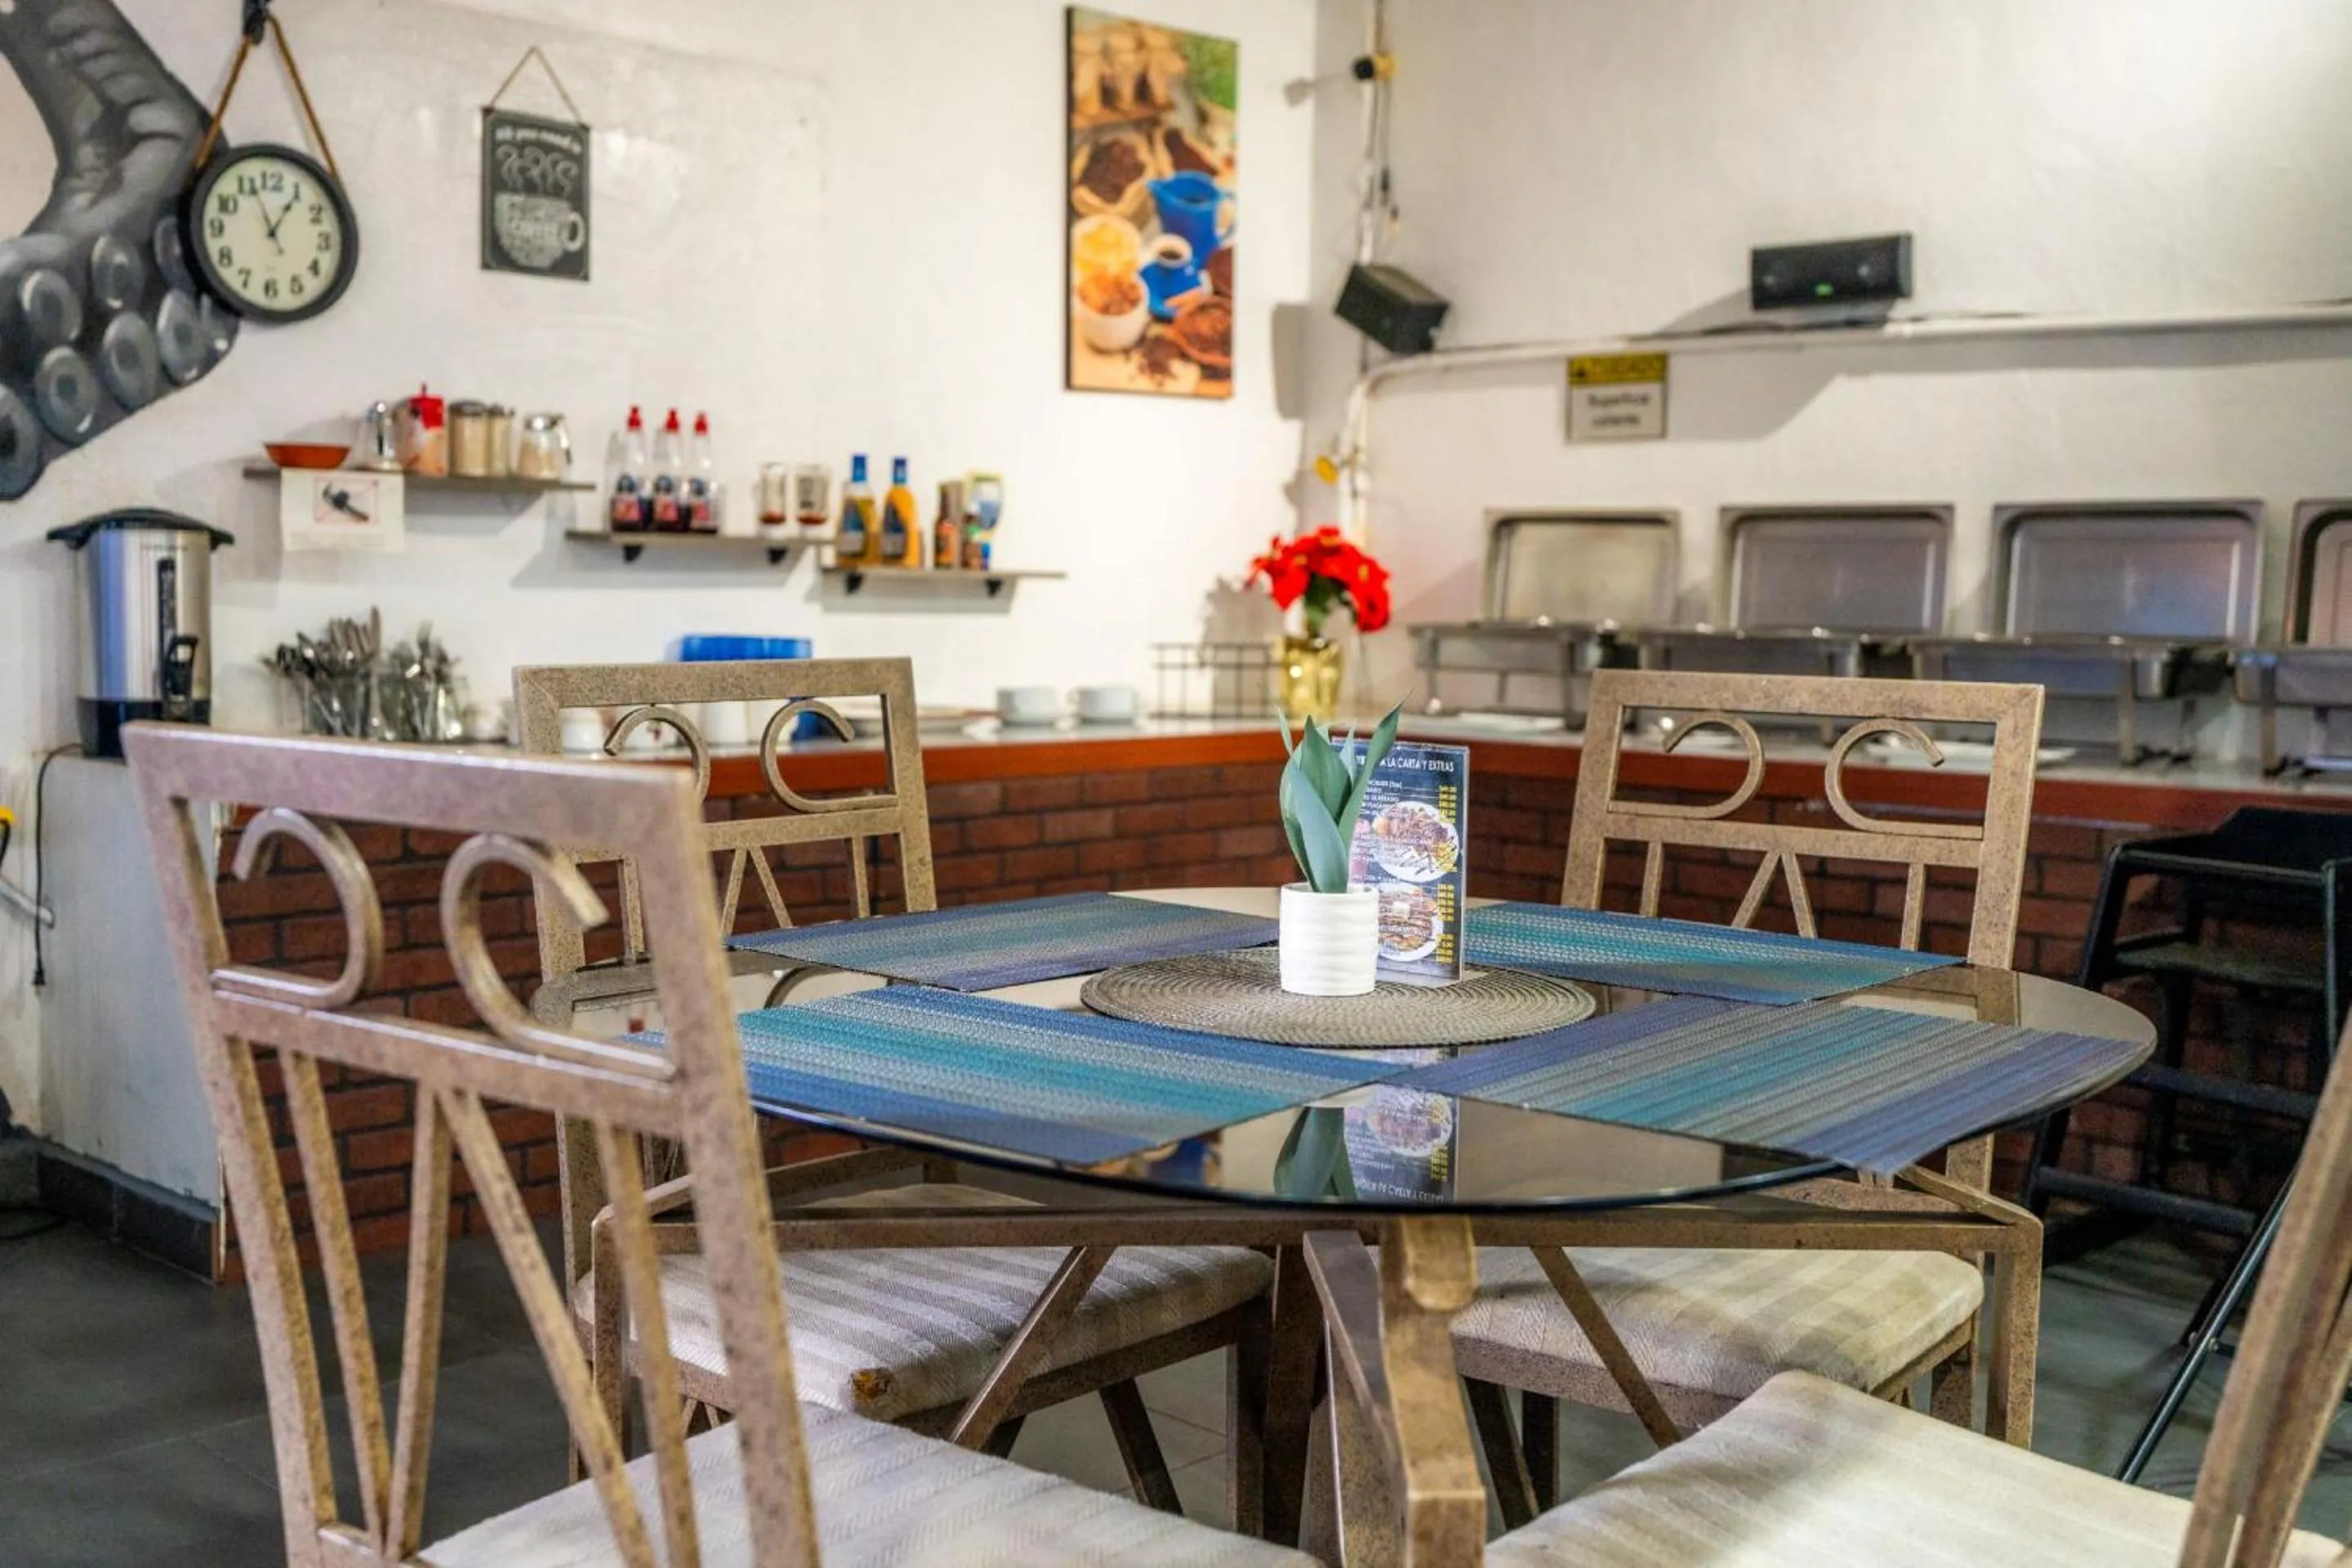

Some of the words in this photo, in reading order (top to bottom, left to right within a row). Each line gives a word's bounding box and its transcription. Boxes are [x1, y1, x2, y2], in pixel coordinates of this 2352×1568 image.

[237, 174, 258, 196] 11
[260, 170, 284, 193] 12
[293, 180, 301, 202] 1
[217, 193, 238, 214] 10
[309, 203, 323, 225] 2
[209, 217, 225, 238] 9
[317, 231, 332, 252] 3
[218, 246, 233, 267] 8
[237, 267, 252, 288] 7
[307, 258, 321, 278] 4
[264, 278, 278, 299] 6
[290, 274, 305, 295] 5
[1388, 758, 1396, 768] LA
[1397, 757, 1422, 770] CARTA
[1428, 760, 1454, 773] EXTRAS
